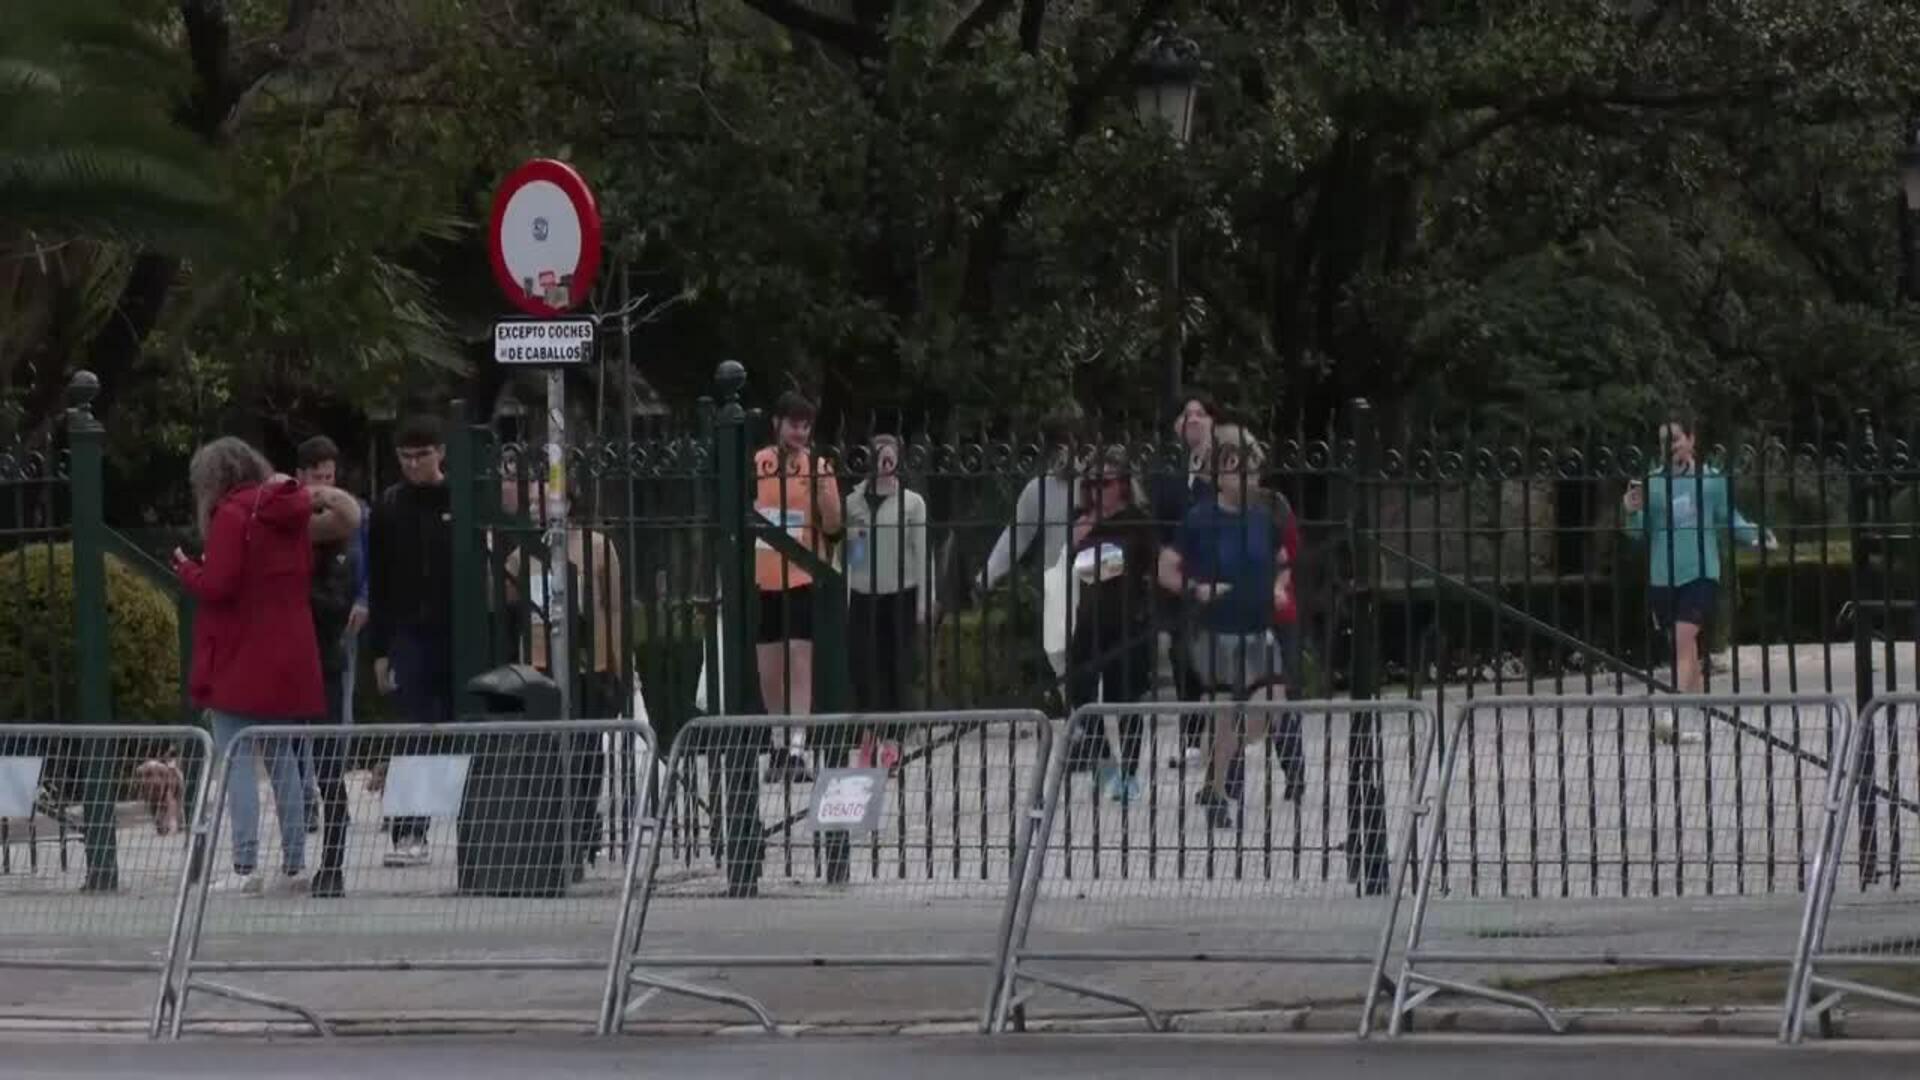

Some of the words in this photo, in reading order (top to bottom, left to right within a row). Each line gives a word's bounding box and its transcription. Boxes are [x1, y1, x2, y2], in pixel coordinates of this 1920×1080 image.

[498, 326, 545, 339] EXCEPTO
[548, 325, 591, 338] COCHES
[508, 347, 523, 360] DE
[525, 347, 580, 360] CABALLOS
